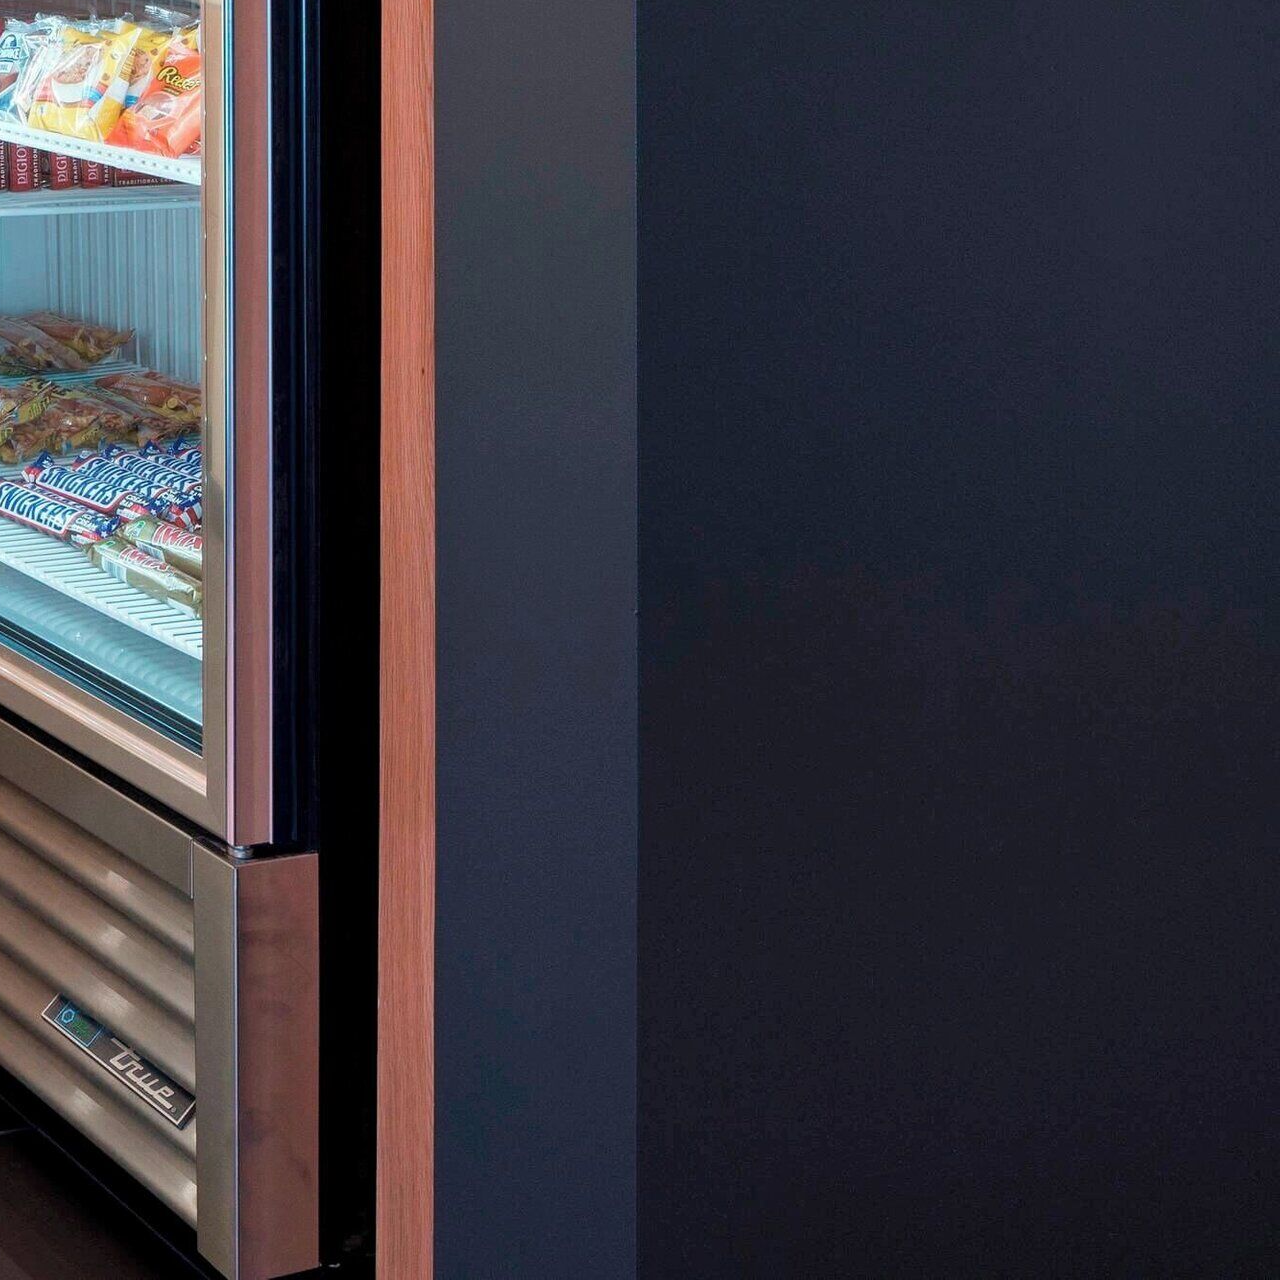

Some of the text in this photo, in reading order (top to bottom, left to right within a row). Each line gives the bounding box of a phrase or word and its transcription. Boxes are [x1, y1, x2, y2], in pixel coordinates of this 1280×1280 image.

[16, 145, 28, 185] DIGIO
[118, 177, 158, 186] TRADITIONAL
[40, 467, 125, 506] SNICKERS
[80, 458, 166, 501] SNICKERS
[117, 454, 200, 493] SNICKERS
